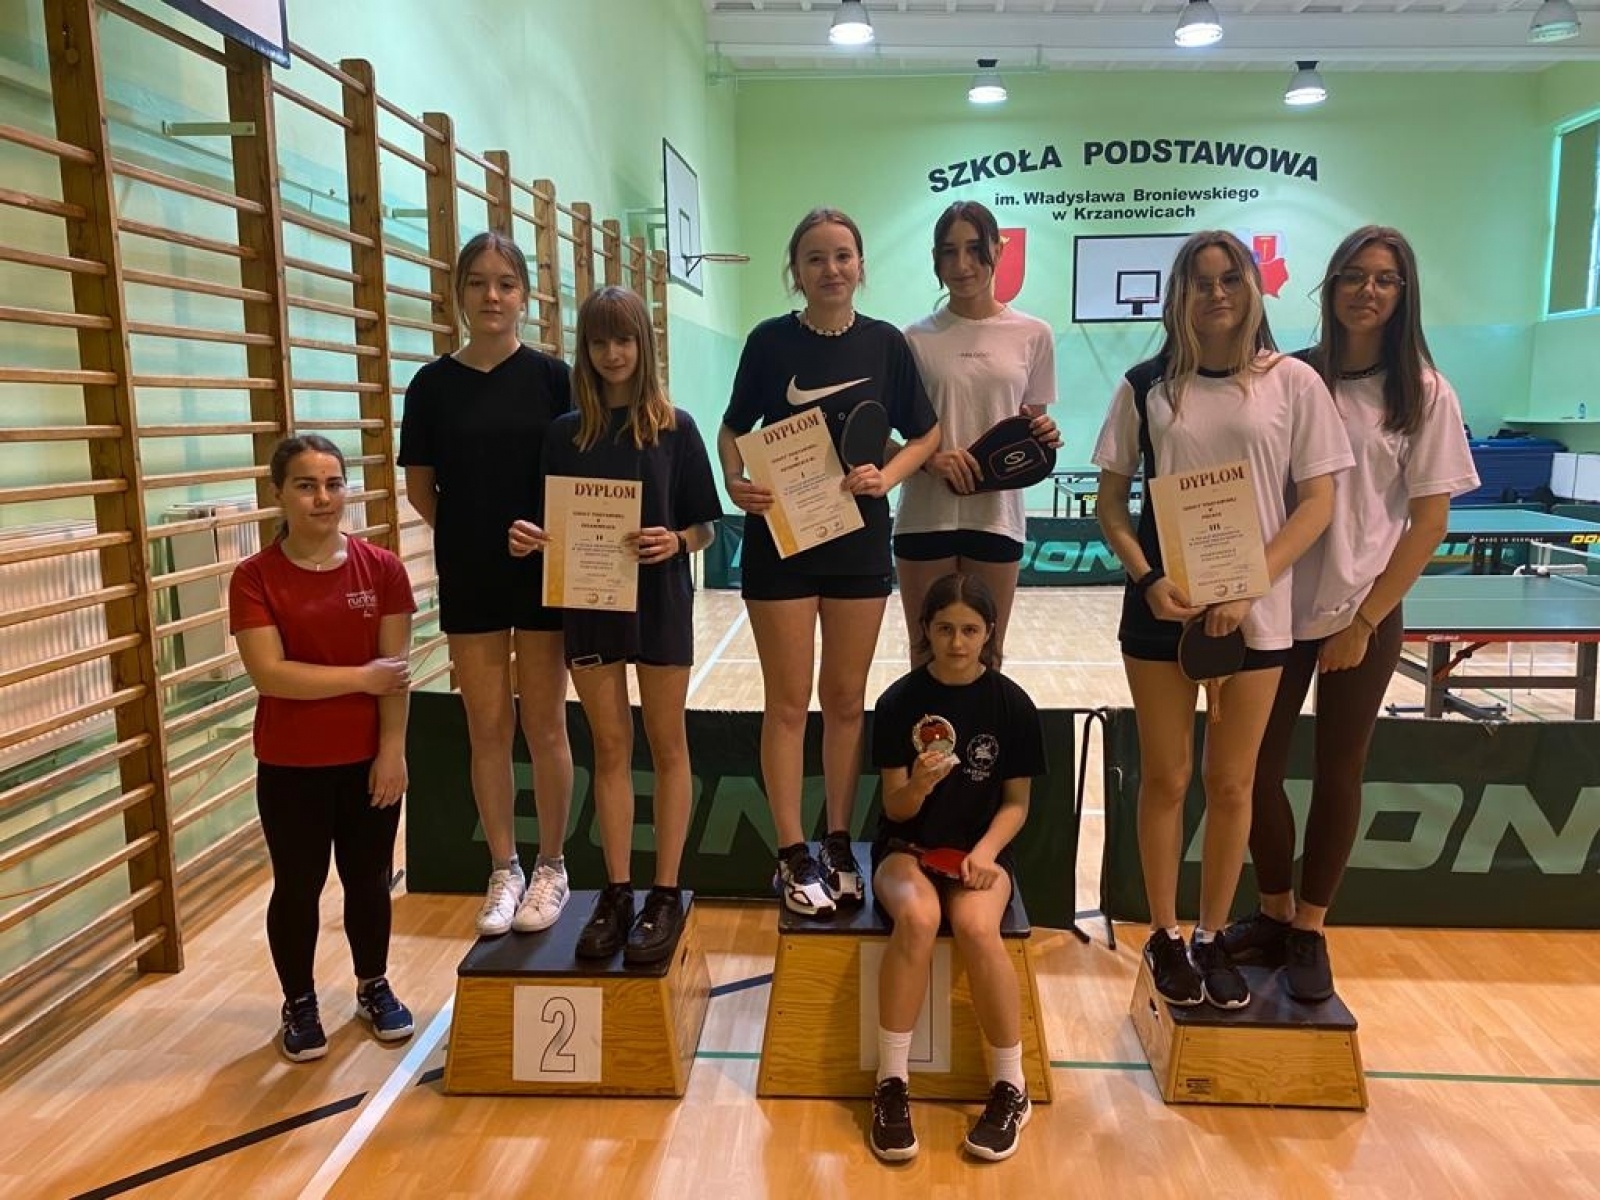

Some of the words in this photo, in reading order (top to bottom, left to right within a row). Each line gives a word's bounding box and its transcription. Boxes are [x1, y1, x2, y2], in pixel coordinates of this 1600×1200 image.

[928, 144, 1063, 193] SZKOŁA
[1084, 139, 1318, 181] PODSTAWOWA
[995, 193, 1020, 205] im.
[1024, 190, 1125, 206] Władysława
[1133, 187, 1259, 202] Broniewskiego
[1052, 210, 1067, 221] w
[1074, 205, 1195, 220] Krzanowicach
[763, 413, 820, 445] DYPLOM
[1179, 465, 1245, 491] DYPLOM
[574, 482, 637, 499] DYPLOM
[1571, 533, 1600, 545] DO
[540, 996, 575, 1072] 2
